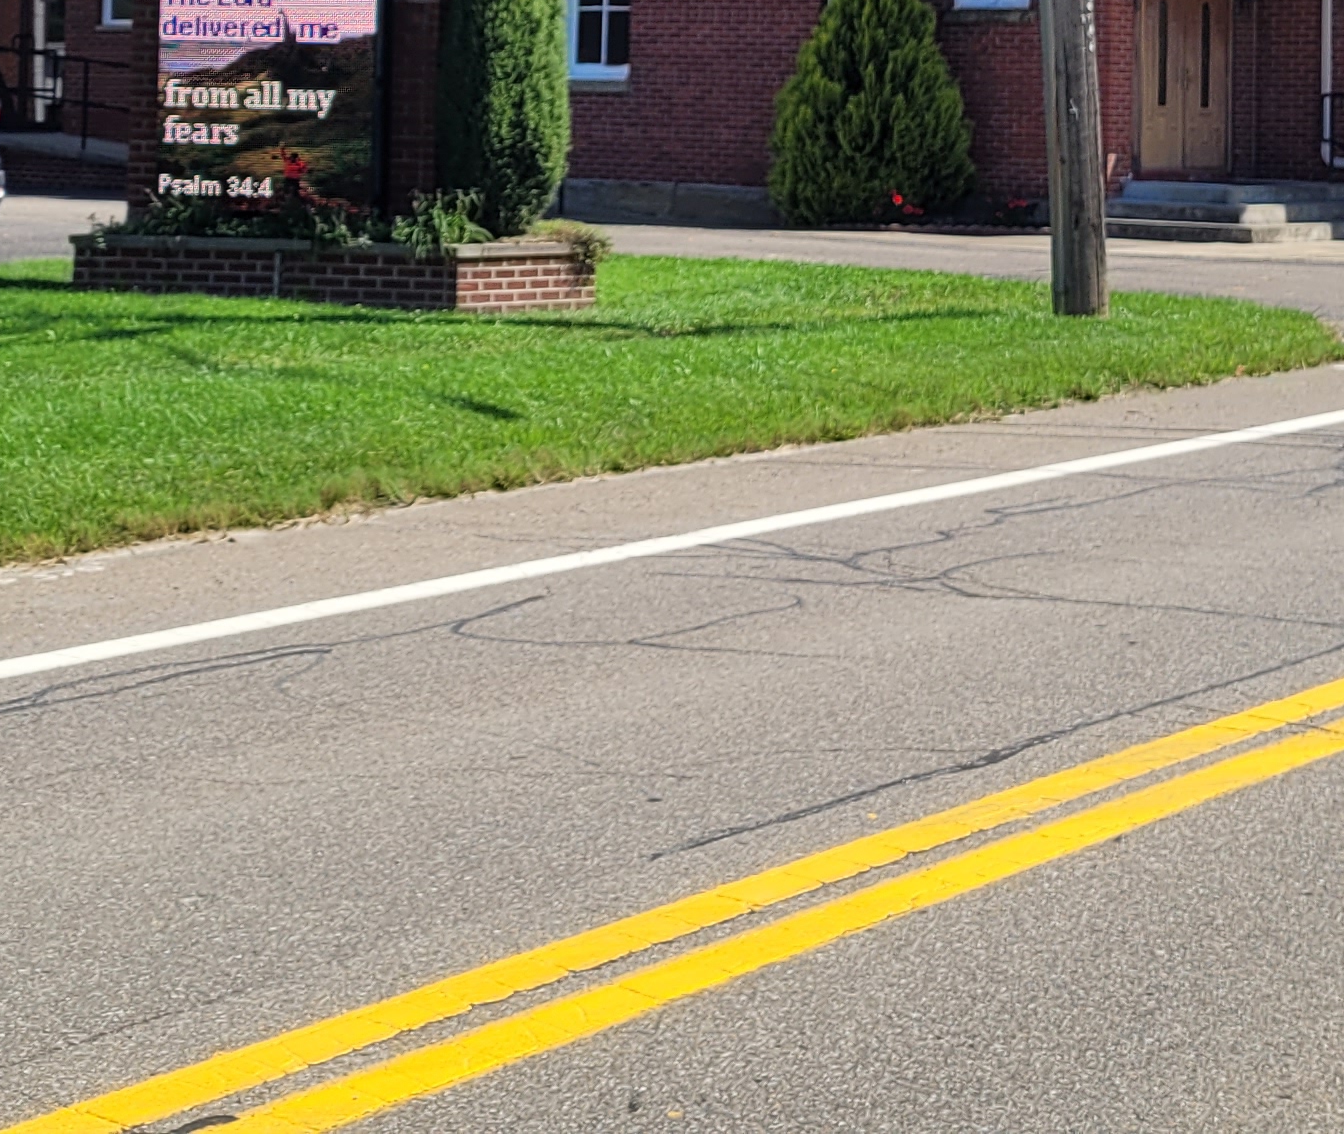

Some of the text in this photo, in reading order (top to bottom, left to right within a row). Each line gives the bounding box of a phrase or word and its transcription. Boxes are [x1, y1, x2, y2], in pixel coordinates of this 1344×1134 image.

[162, 16, 339, 39] delivered me
[163, 79, 337, 119] from all my
[163, 114, 240, 145] fears
[158, 173, 274, 199] Psalm 34:4
